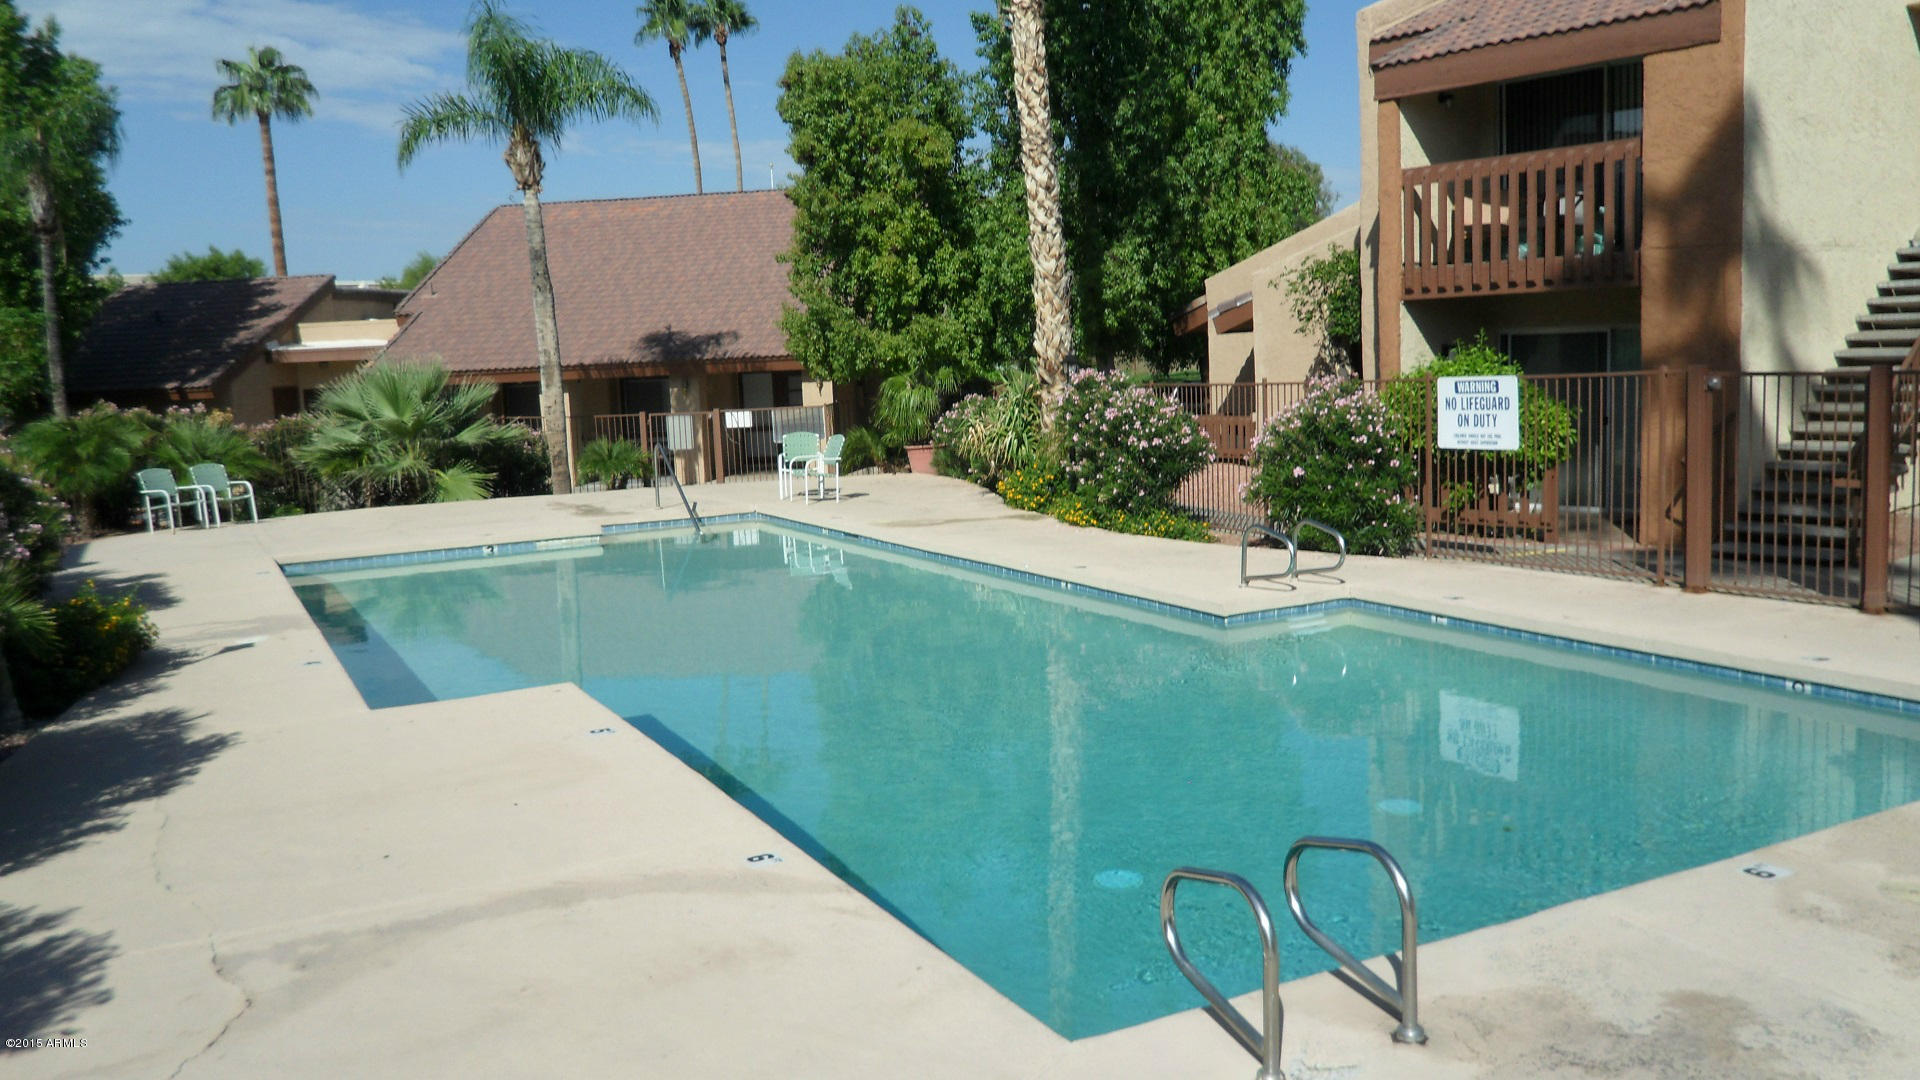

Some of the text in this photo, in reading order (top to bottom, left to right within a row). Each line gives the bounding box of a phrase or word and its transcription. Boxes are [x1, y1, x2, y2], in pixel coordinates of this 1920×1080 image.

[1457, 381, 1497, 393] WARNING
[1445, 396, 1511, 411] NO LIFEGUARD
[1457, 413, 1498, 428] ON DUTY
